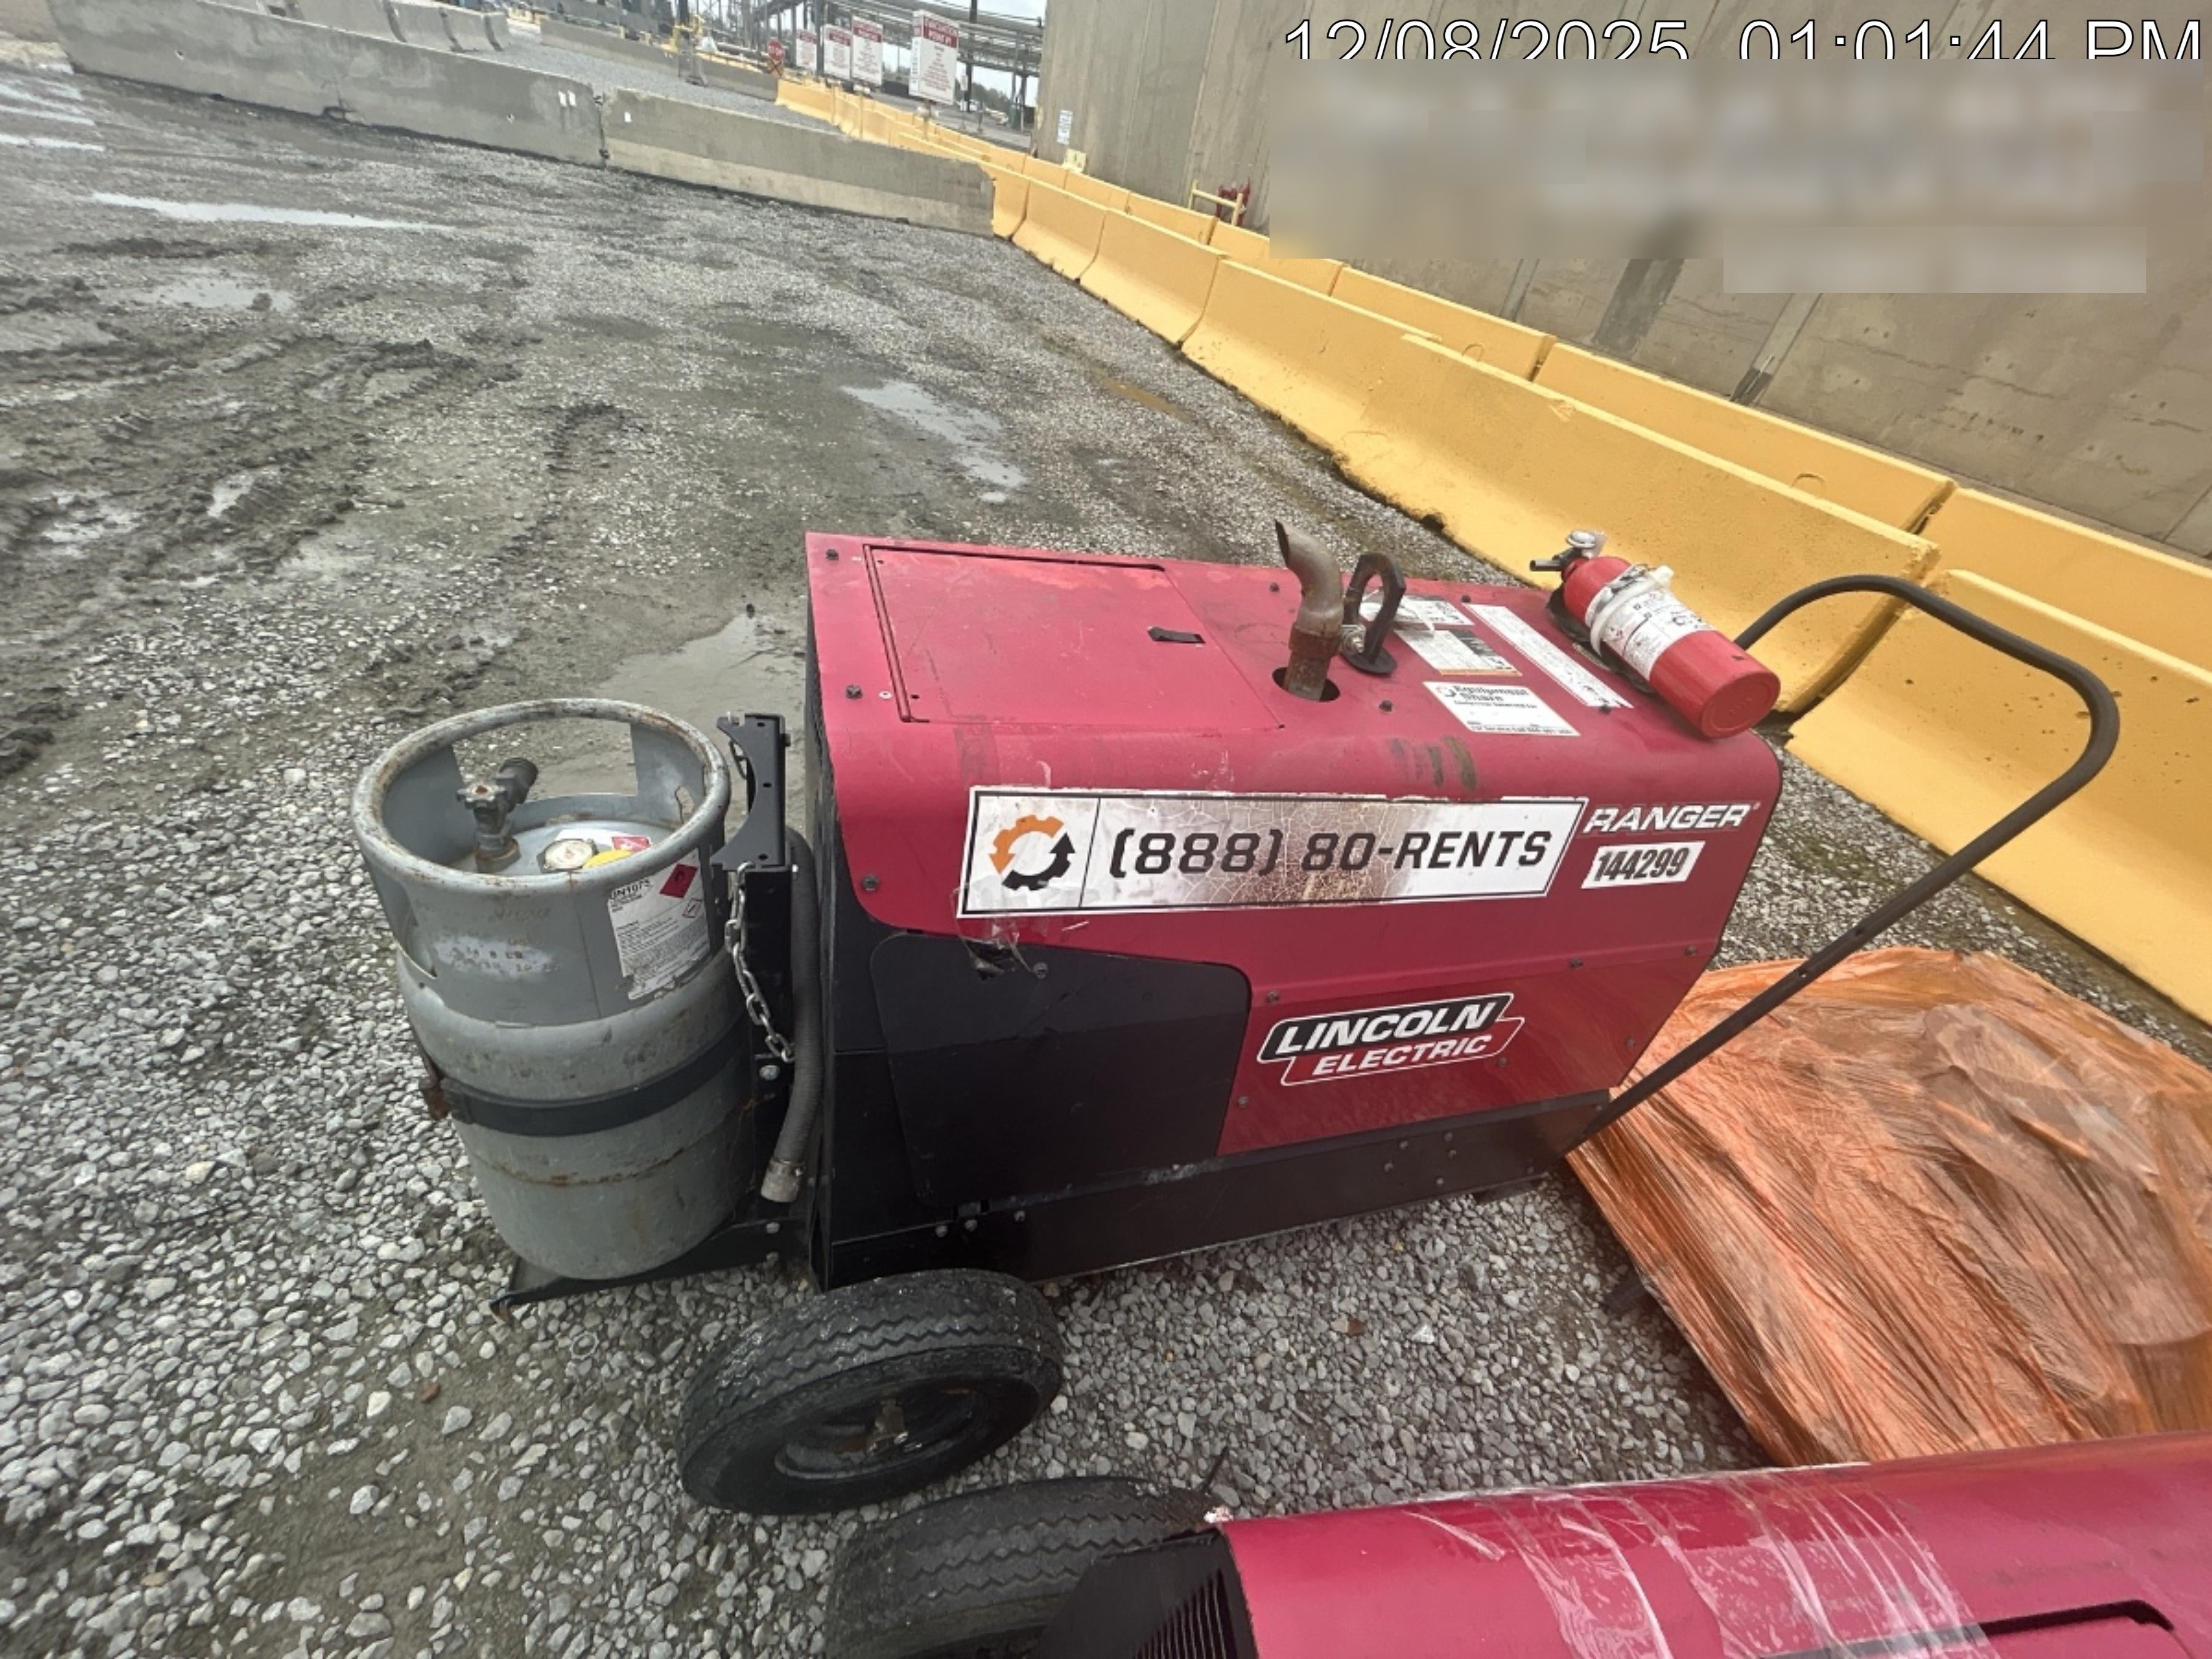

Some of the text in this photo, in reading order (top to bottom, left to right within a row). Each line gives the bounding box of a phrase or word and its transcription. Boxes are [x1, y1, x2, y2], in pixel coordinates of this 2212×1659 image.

[1582, 803, 1752, 834] RANGER
[1110, 828, 1553, 879] (888) 80-RENTS
[1594, 847, 1690, 882] 144299
[1276, 1002, 1496, 1055] LINCOLN
[1312, 1035, 1493, 1076] ELECTRIC
